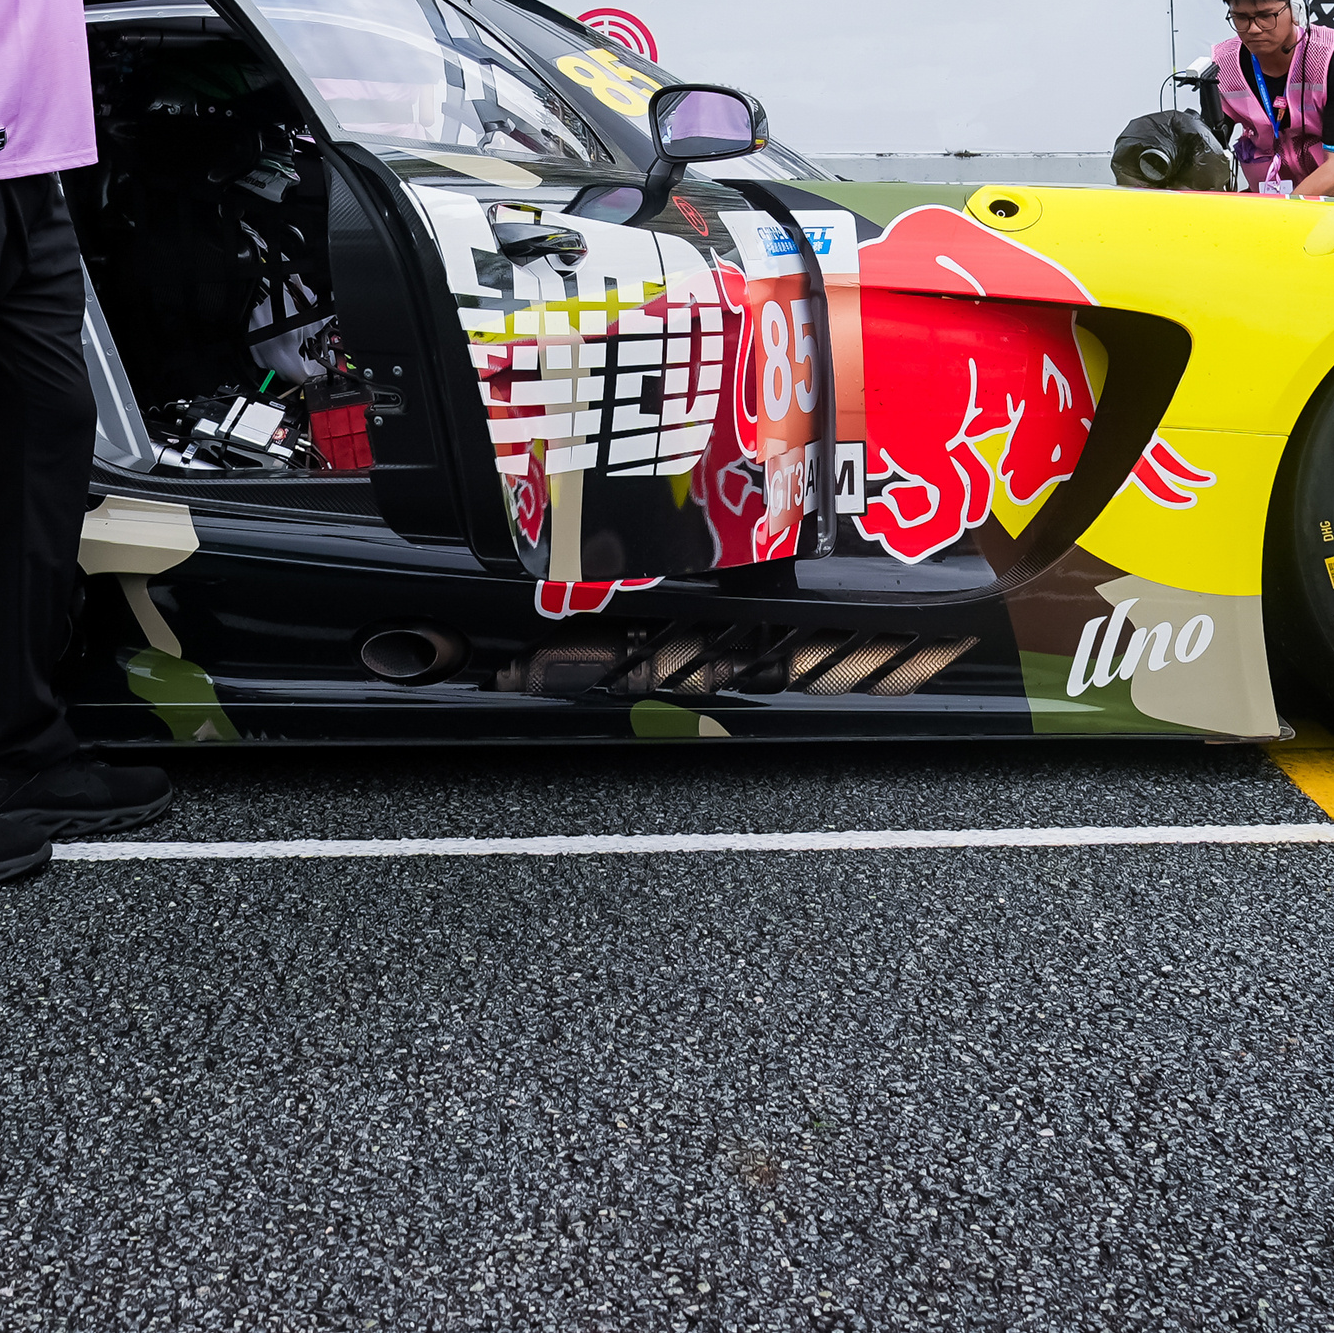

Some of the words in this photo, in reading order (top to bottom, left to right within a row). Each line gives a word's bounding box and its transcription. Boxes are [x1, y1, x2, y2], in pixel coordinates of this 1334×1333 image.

[556, 48, 665, 117] 85
[761, 298, 818, 422] 85
[769, 464, 805, 518] GT3
[1319, 520, 1334, 543] DHG
